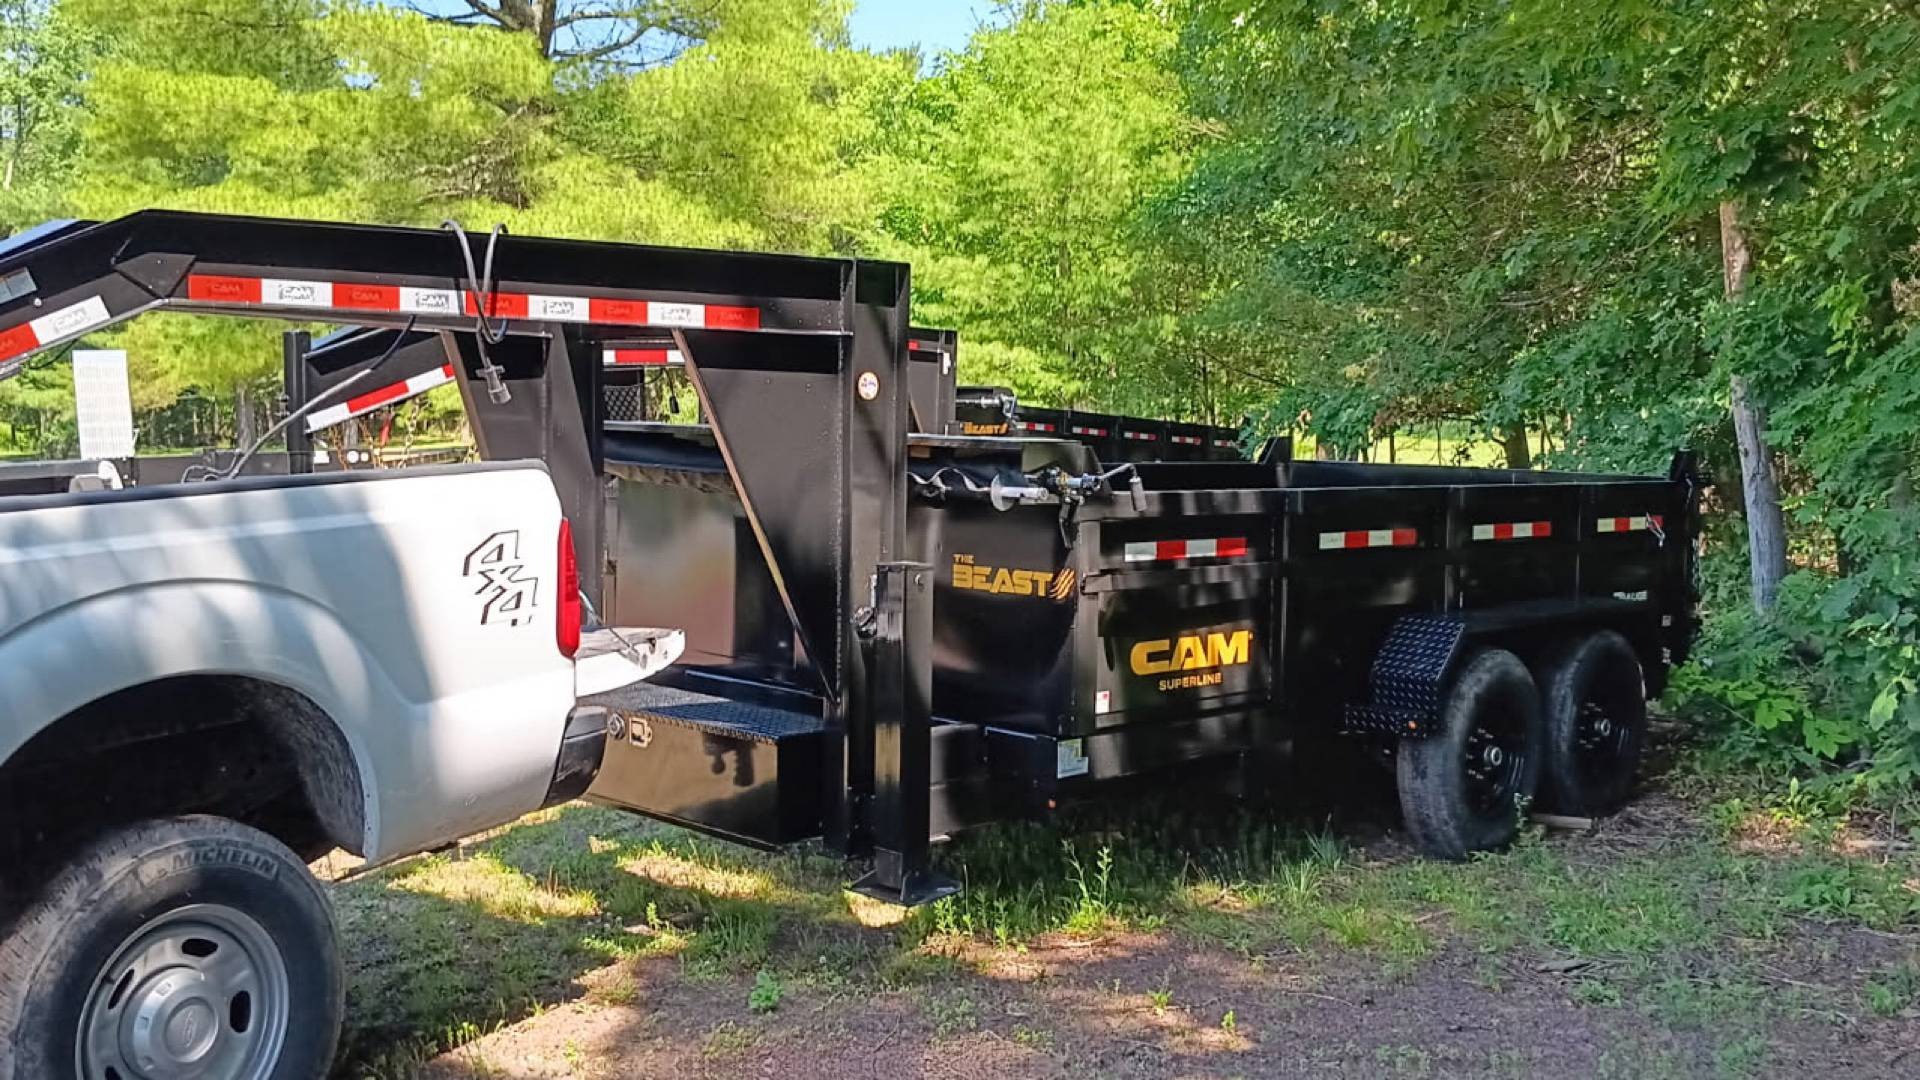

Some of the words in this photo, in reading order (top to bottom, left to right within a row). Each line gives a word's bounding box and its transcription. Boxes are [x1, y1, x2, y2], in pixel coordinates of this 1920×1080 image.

[953, 554, 974, 564] THE
[952, 564, 1053, 597] BEAST
[1130, 630, 1249, 675] CAM
[1159, 672, 1222, 691] SUPERLINE
[172, 847, 278, 878] MICHELIN
